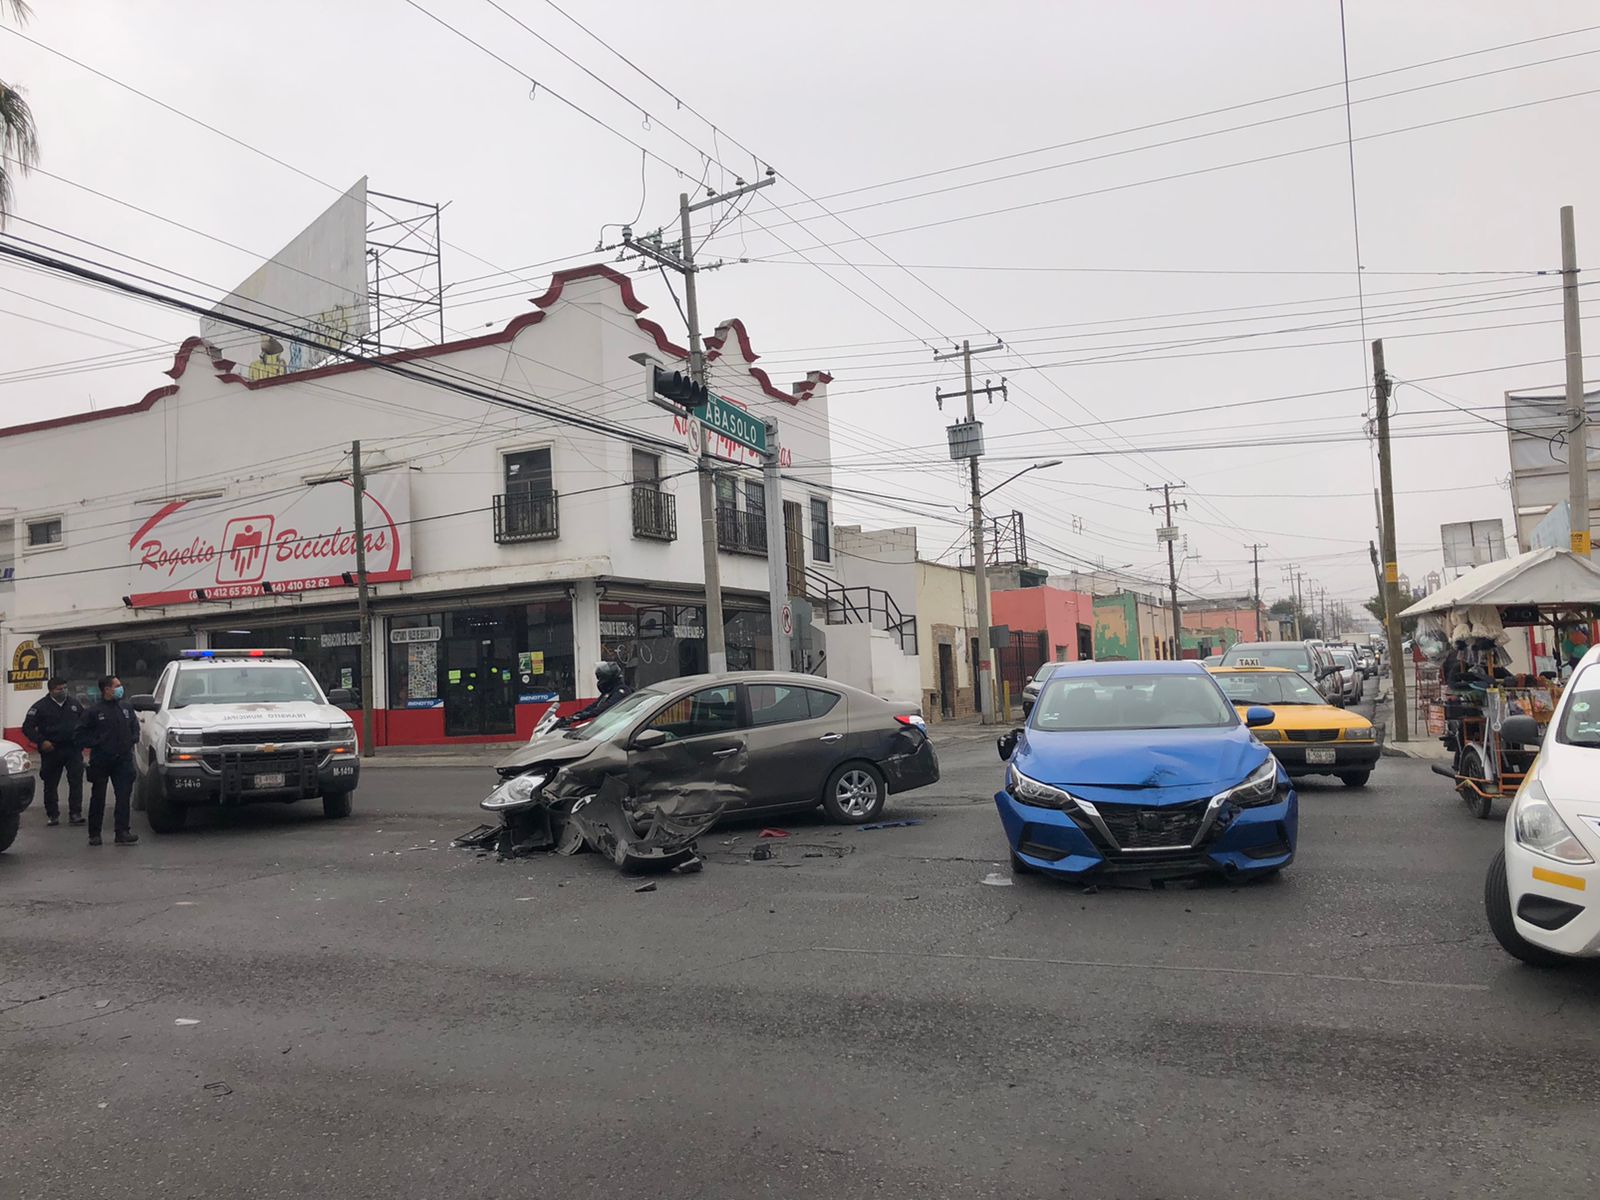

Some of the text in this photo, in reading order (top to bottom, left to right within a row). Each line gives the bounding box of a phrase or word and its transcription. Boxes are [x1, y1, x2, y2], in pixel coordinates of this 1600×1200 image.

[705, 402, 757, 444] ABASOLO
[139, 526, 386, 577] Rogelio Bicicletas
[213, 588, 228, 598] 412
[229, 587, 240, 597] 65
[241, 586, 253, 596] 29
[287, 581, 304, 591] 410
